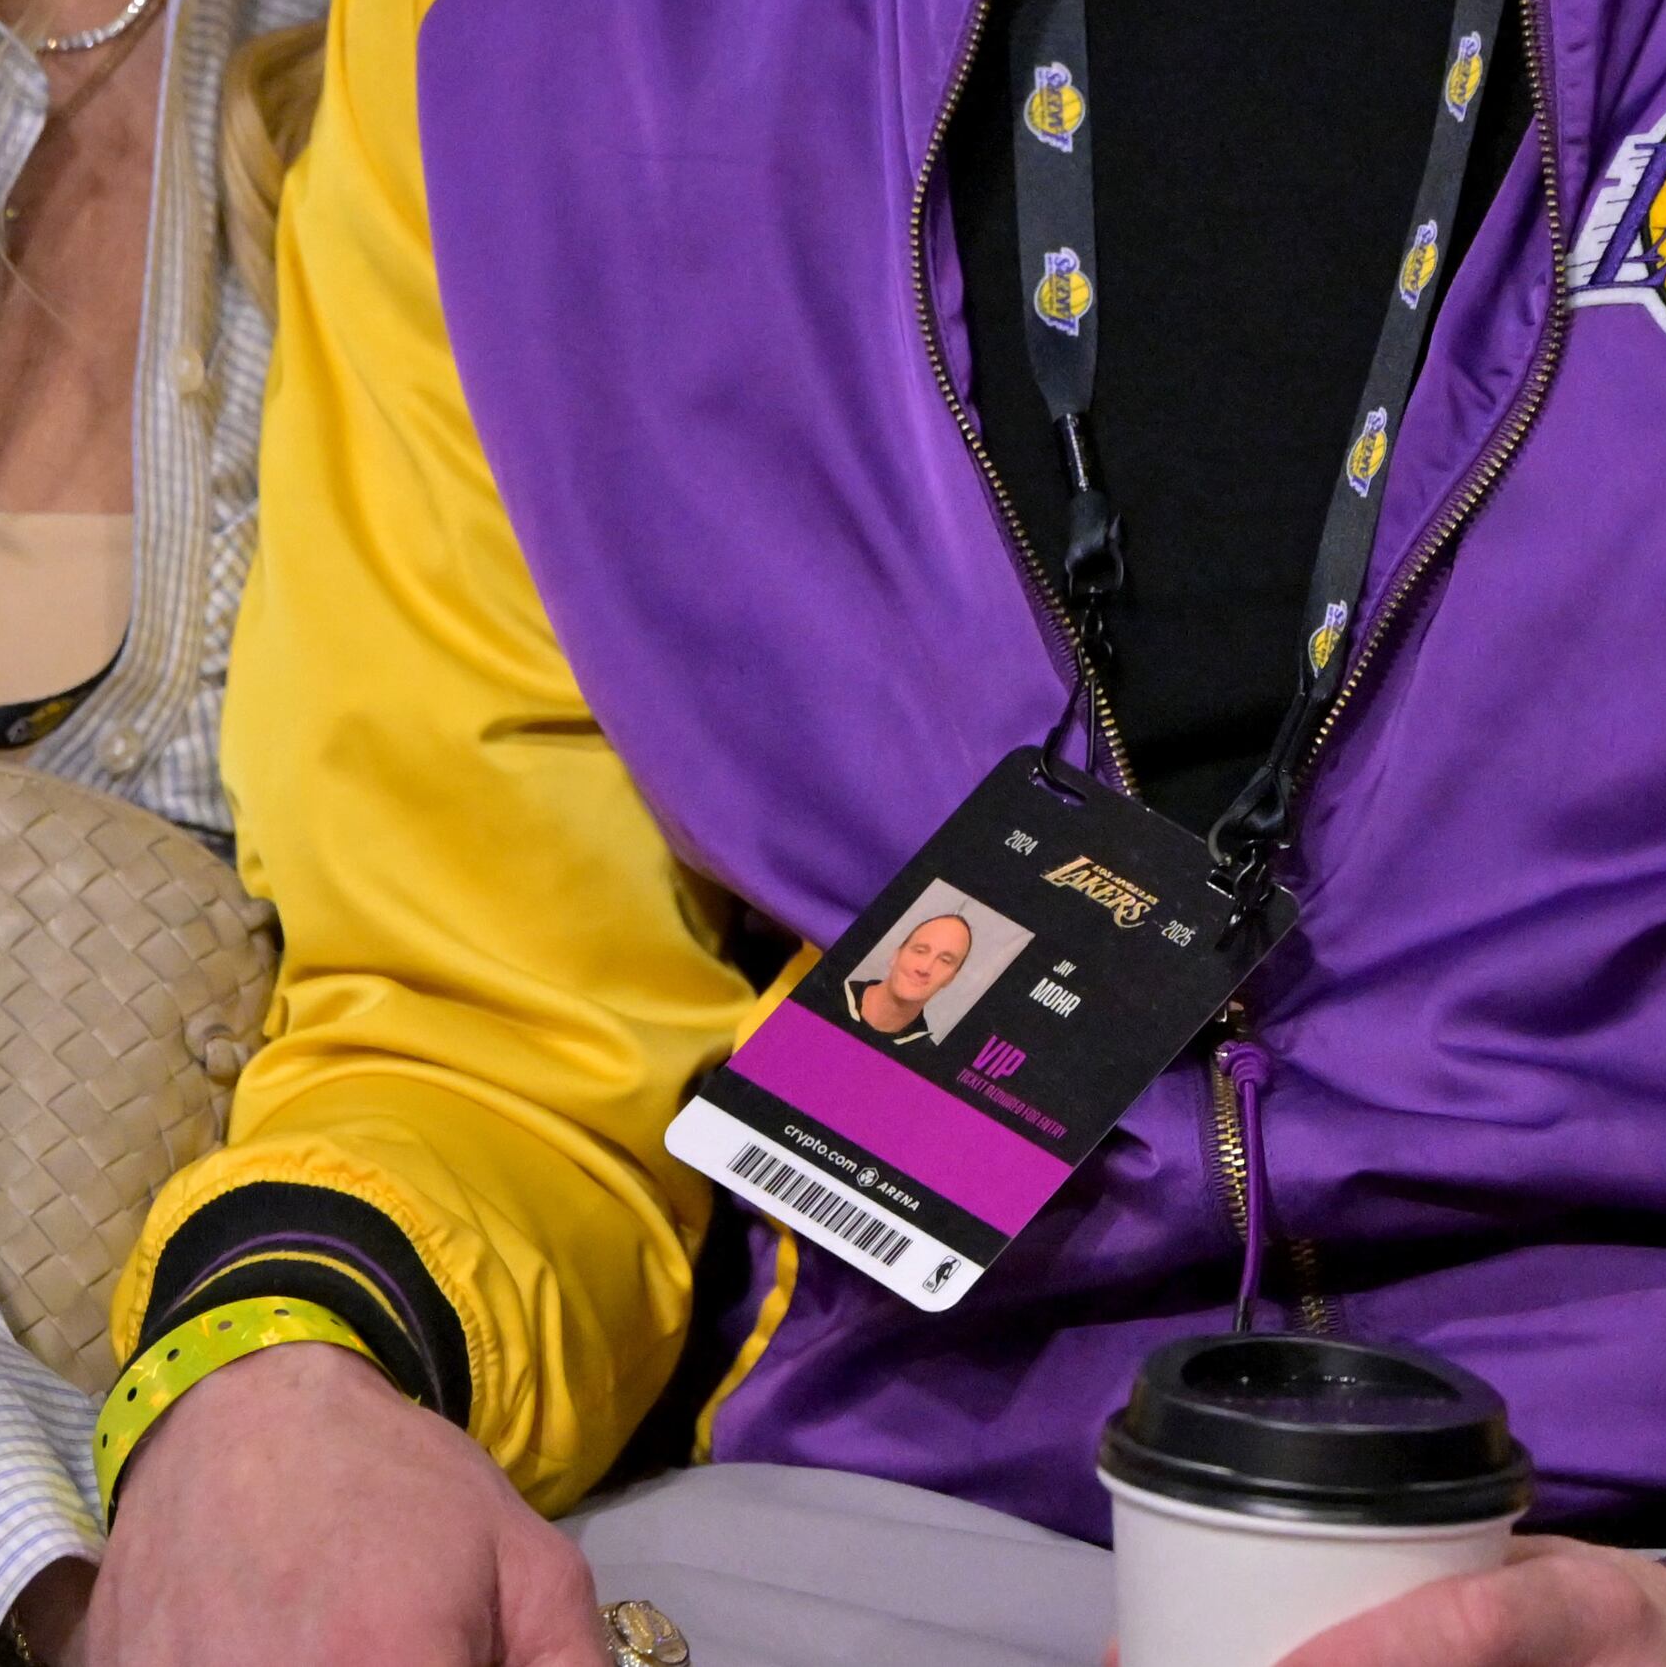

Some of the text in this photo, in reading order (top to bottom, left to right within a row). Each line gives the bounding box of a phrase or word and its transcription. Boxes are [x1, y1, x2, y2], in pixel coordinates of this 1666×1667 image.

[1004, 829, 1039, 857] 2024
[1039, 854, 1152, 929] LAKERS
[1161, 919, 1196, 948] 2025
[1052, 959, 1078, 978] JAY
[1029, 977, 1082, 1019] MOHR
[971, 1034, 1027, 1080] VIP
[956, 1068, 1069, 1140] TICKET REQUIRED FOR ENTRY
[784, 1123, 922, 1212] crypto.com ARENA
